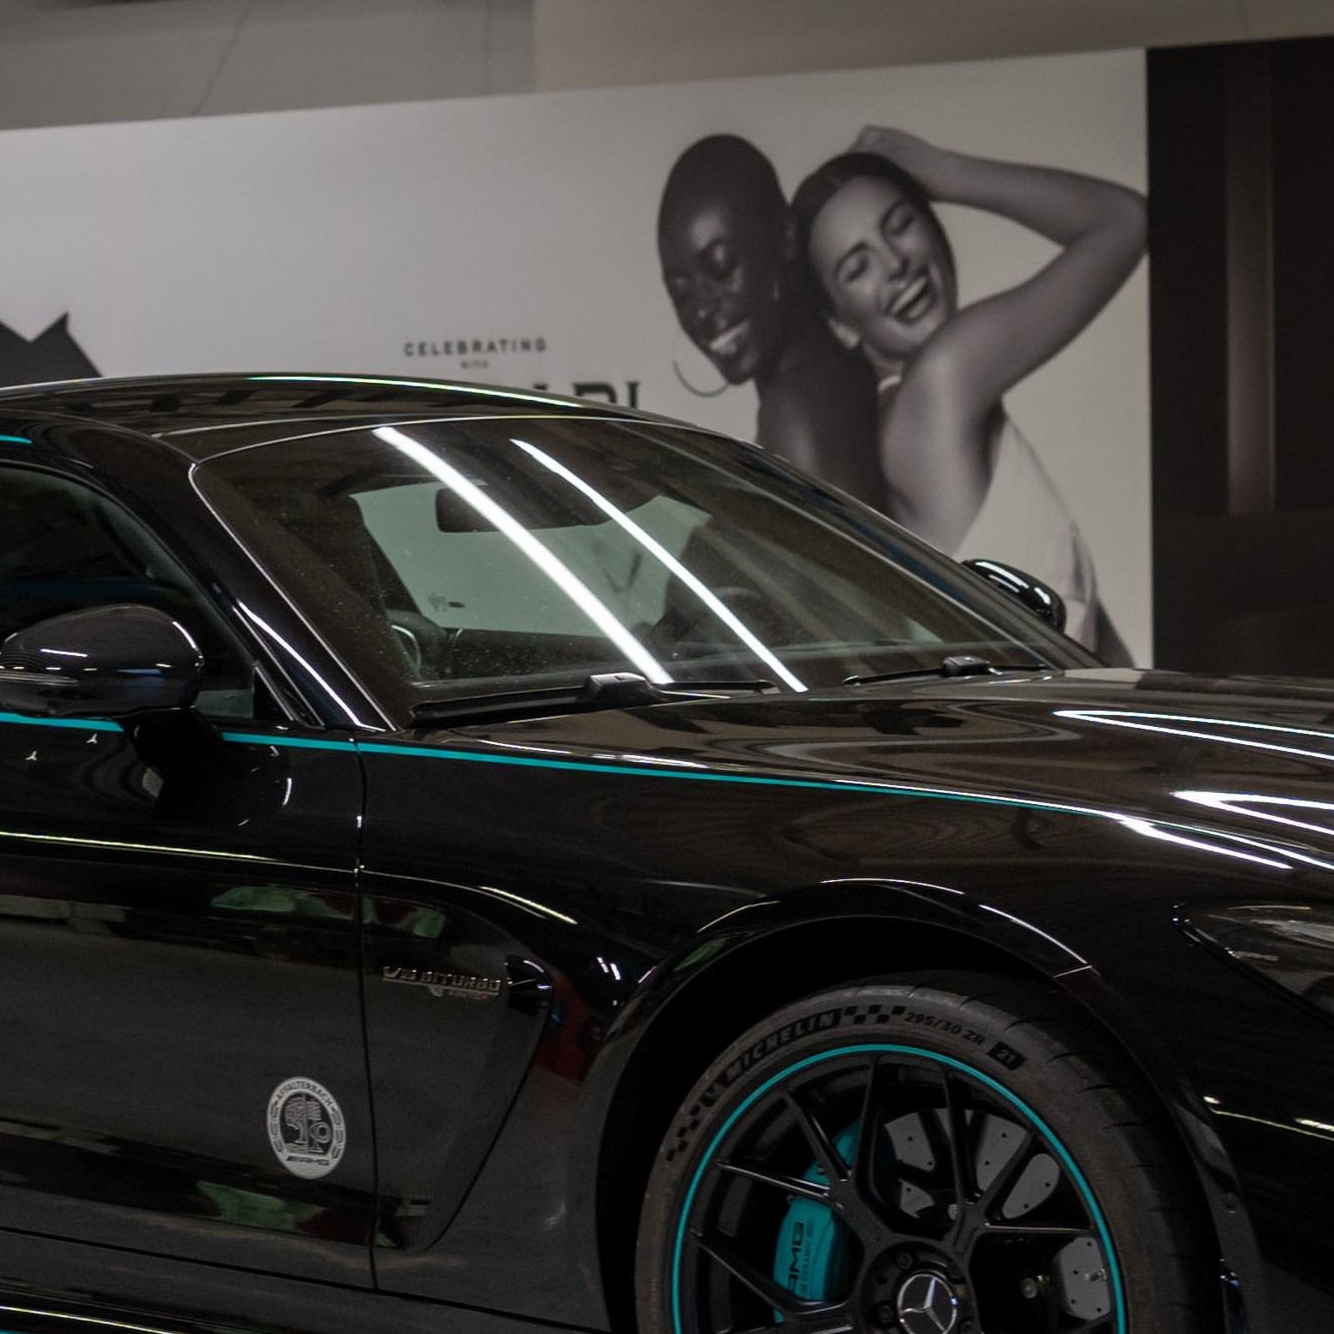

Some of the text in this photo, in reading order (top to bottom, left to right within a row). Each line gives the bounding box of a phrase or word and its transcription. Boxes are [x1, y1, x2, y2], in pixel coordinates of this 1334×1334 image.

[404, 337, 547, 357] CELEBRATING
[726, 1010, 837, 1082] MICHELIN
[904, 1011, 1018, 1065] 295/30 ZR 21
